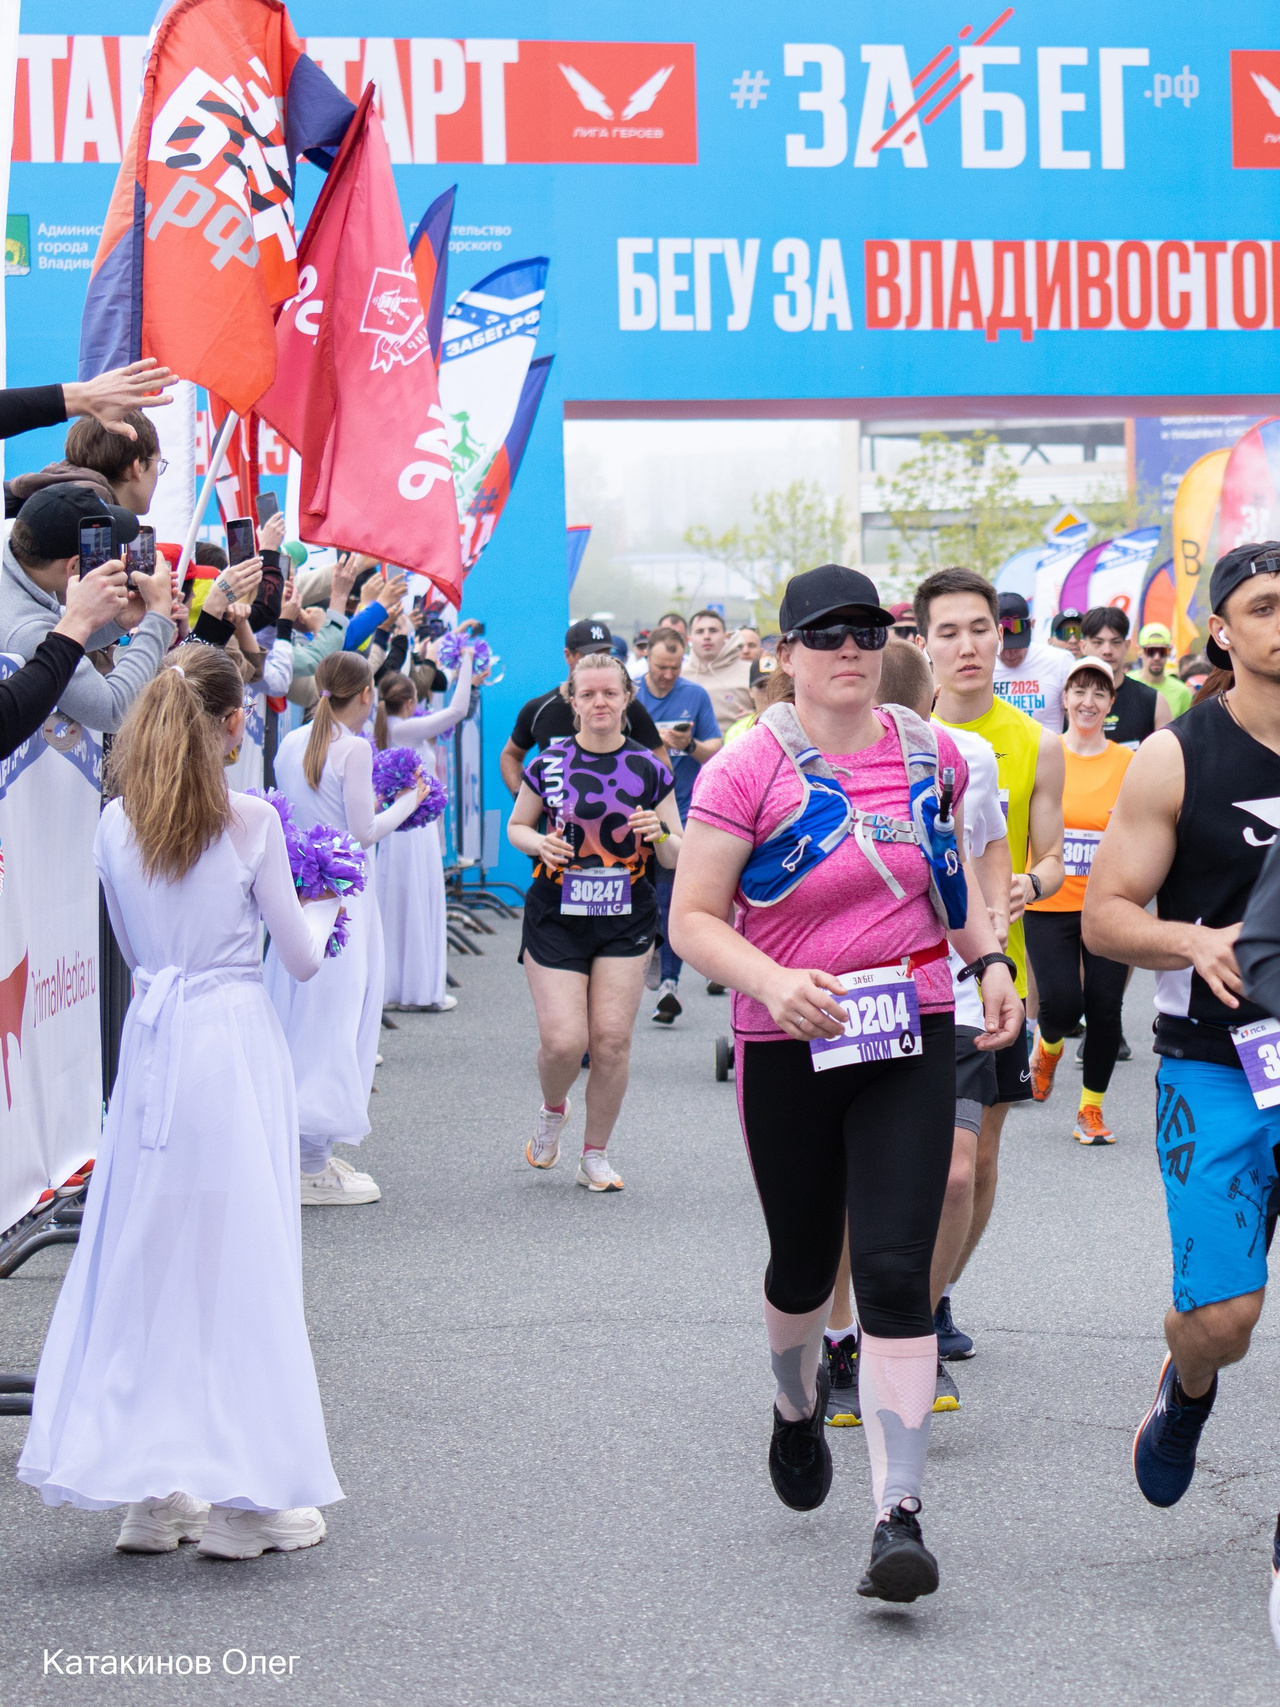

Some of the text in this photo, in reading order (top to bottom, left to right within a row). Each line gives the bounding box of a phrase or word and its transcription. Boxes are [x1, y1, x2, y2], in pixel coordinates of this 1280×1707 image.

[304, 37, 519, 164] ТАРТ
[573, 127, 664, 139] ЛИГА ГЕРОЕВ
[37, 223, 104, 238] Админис
[37, 242, 88, 255] города
[447, 242, 503, 254] орского
[617, 237, 760, 331] БЕГУ
[772, 237, 853, 331] ЗА
[445, 310, 541, 358] ЗАБЕГ.РФ
[1063, 842, 1098, 863] 3018
[570, 879, 625, 902] 30247
[613, 903, 622, 912] C
[838, 992, 911, 1038] 0204
[1250, 1024, 1267, 1035] ПСБ
[902, 1033, 913, 1049] A
